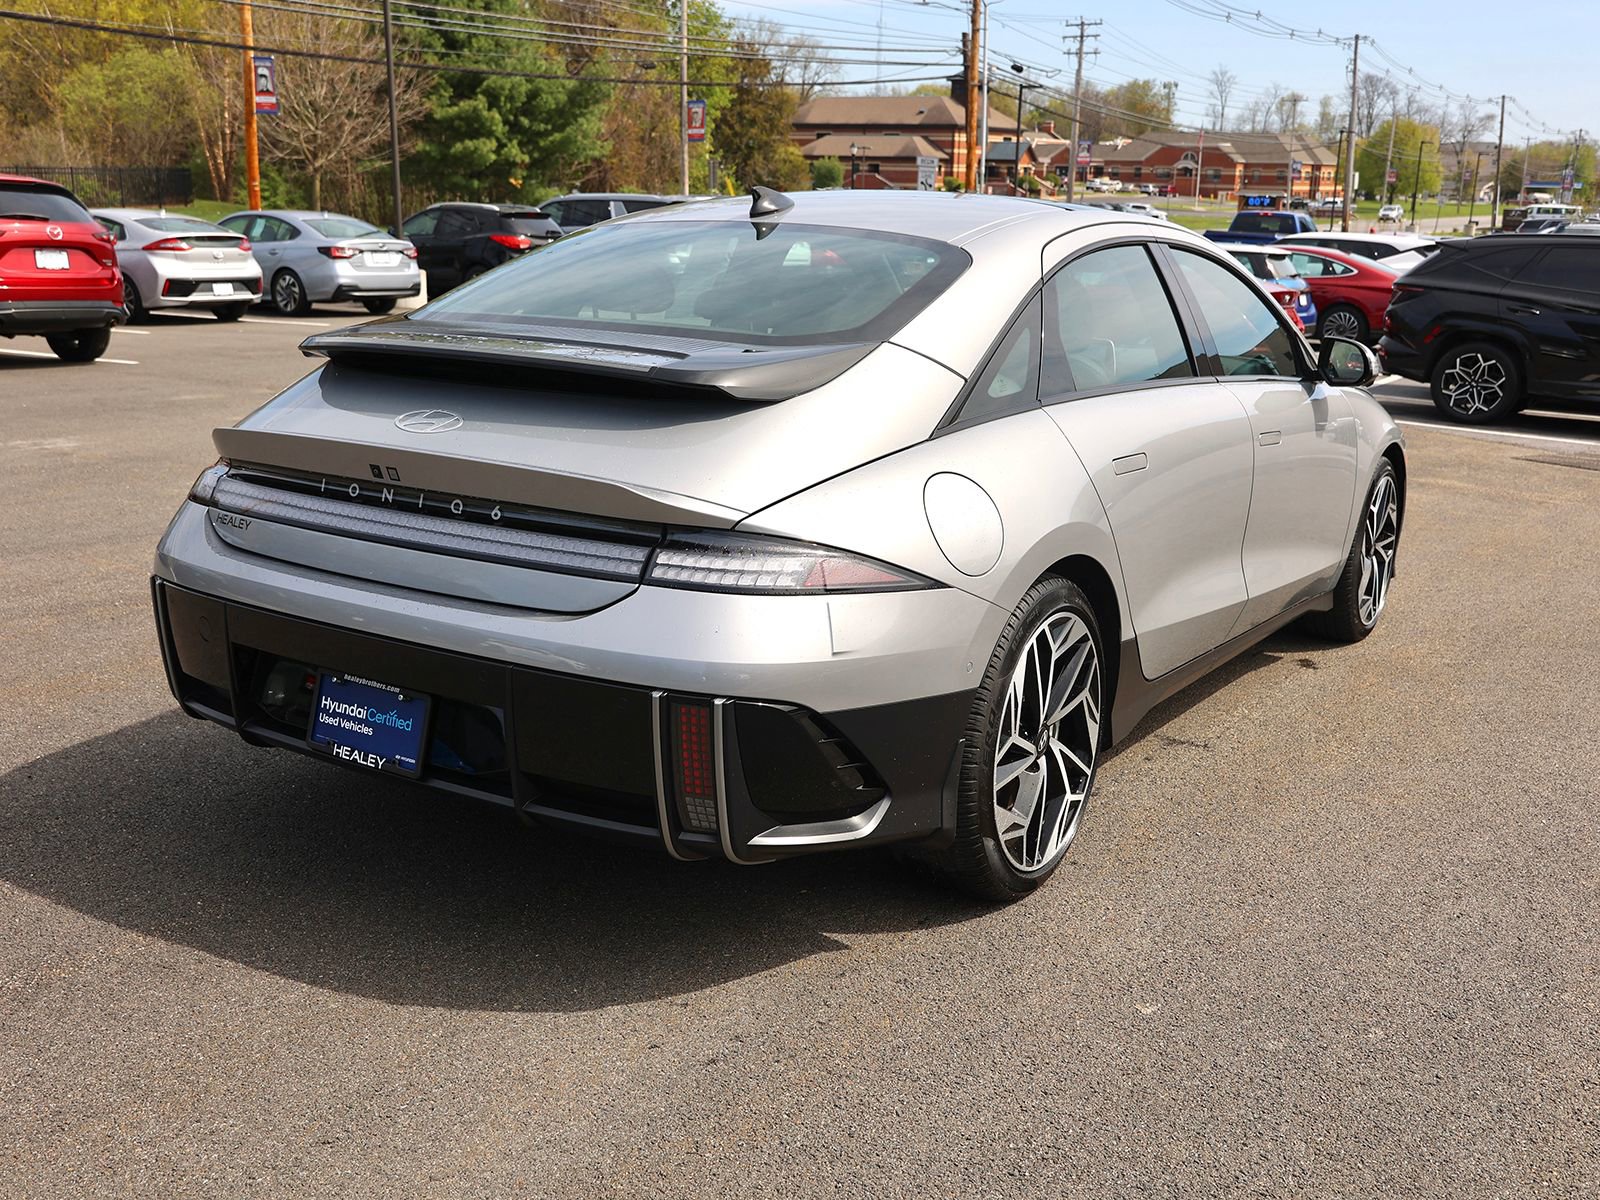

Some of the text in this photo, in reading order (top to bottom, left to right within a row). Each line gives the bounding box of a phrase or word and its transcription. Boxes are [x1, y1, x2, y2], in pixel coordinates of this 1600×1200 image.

[320, 478, 463, 515] IONIQ
[216, 513, 252, 531] HEALEY
[343, 673, 401, 693] healeybrothers.com
[319, 712, 374, 736] Used Vehicles
[321, 695, 413, 731] Hyundai Certified
[333, 743, 387, 770] HEALEY
